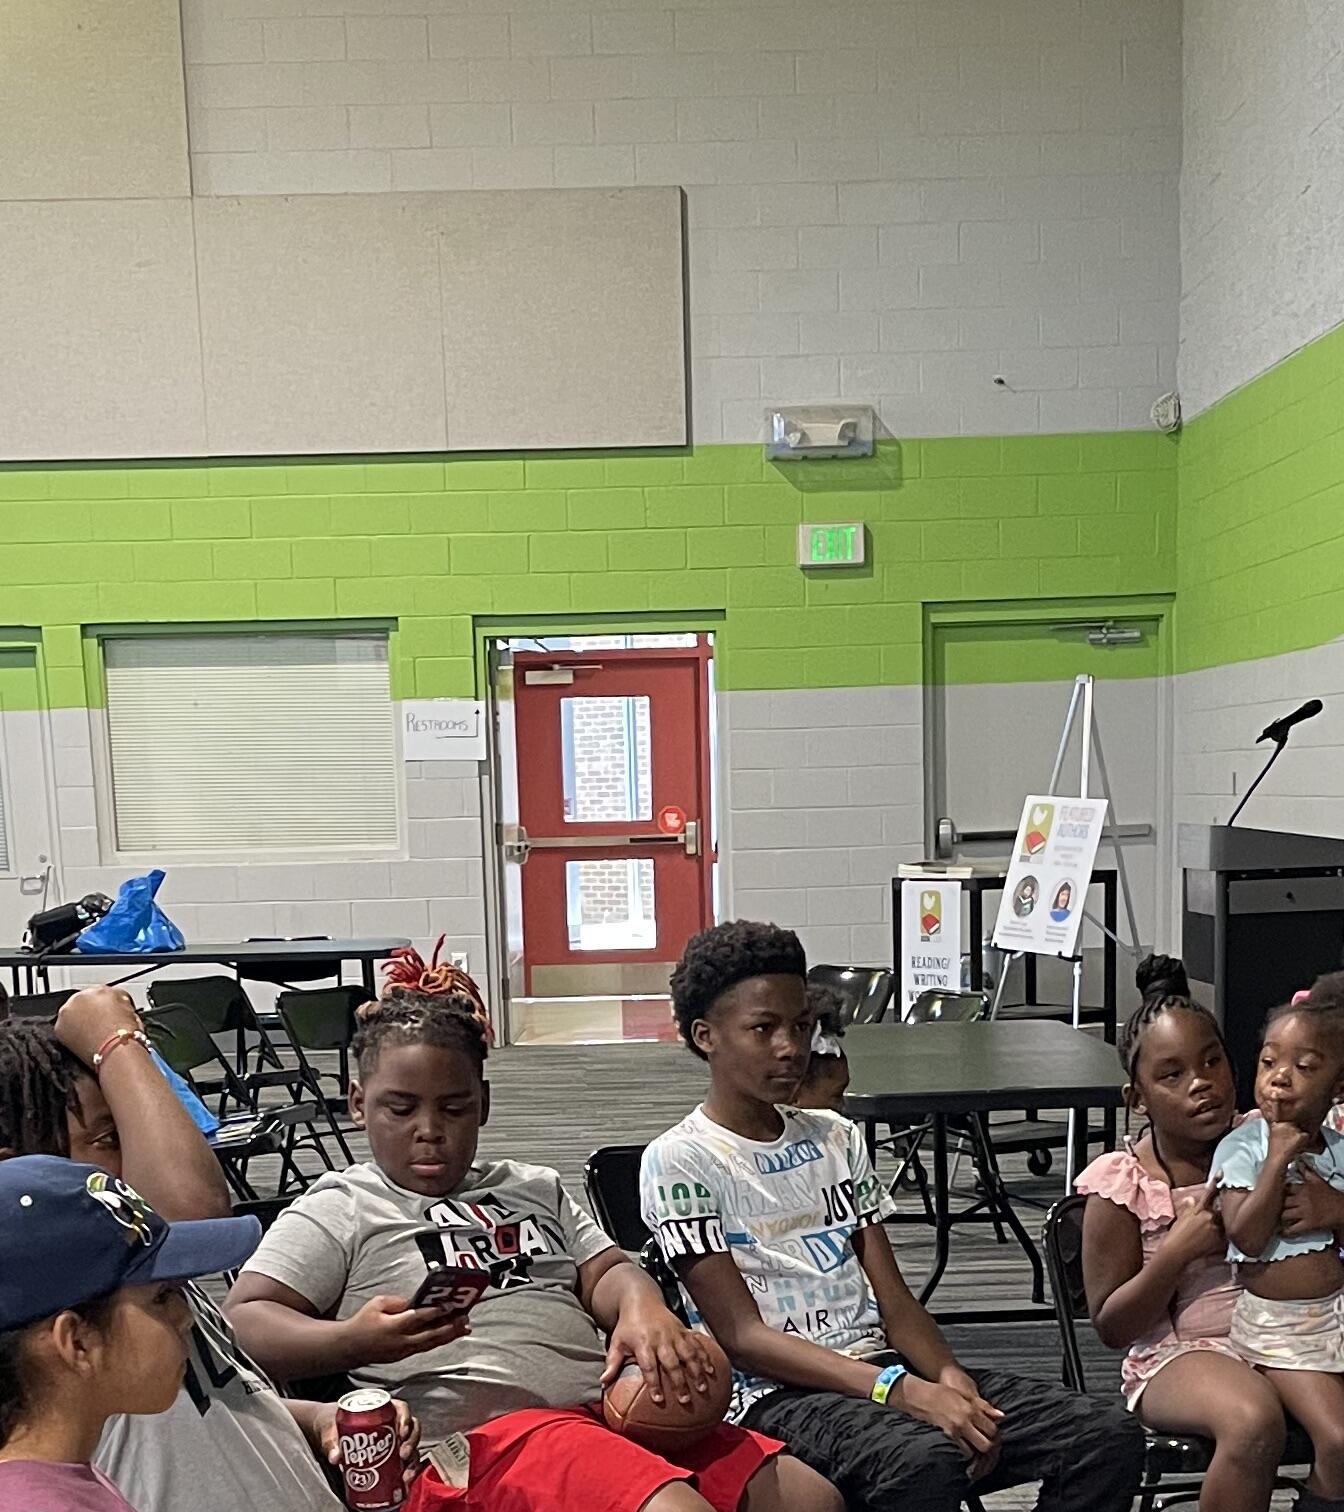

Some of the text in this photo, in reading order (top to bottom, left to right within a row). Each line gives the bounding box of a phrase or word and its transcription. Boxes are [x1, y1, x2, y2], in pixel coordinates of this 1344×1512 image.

[811, 527, 856, 561] EXIT
[911, 955, 951, 970] READING/
[783, 1309, 832, 1334] AIR
[339, 1433, 392, 1467] Pepper
